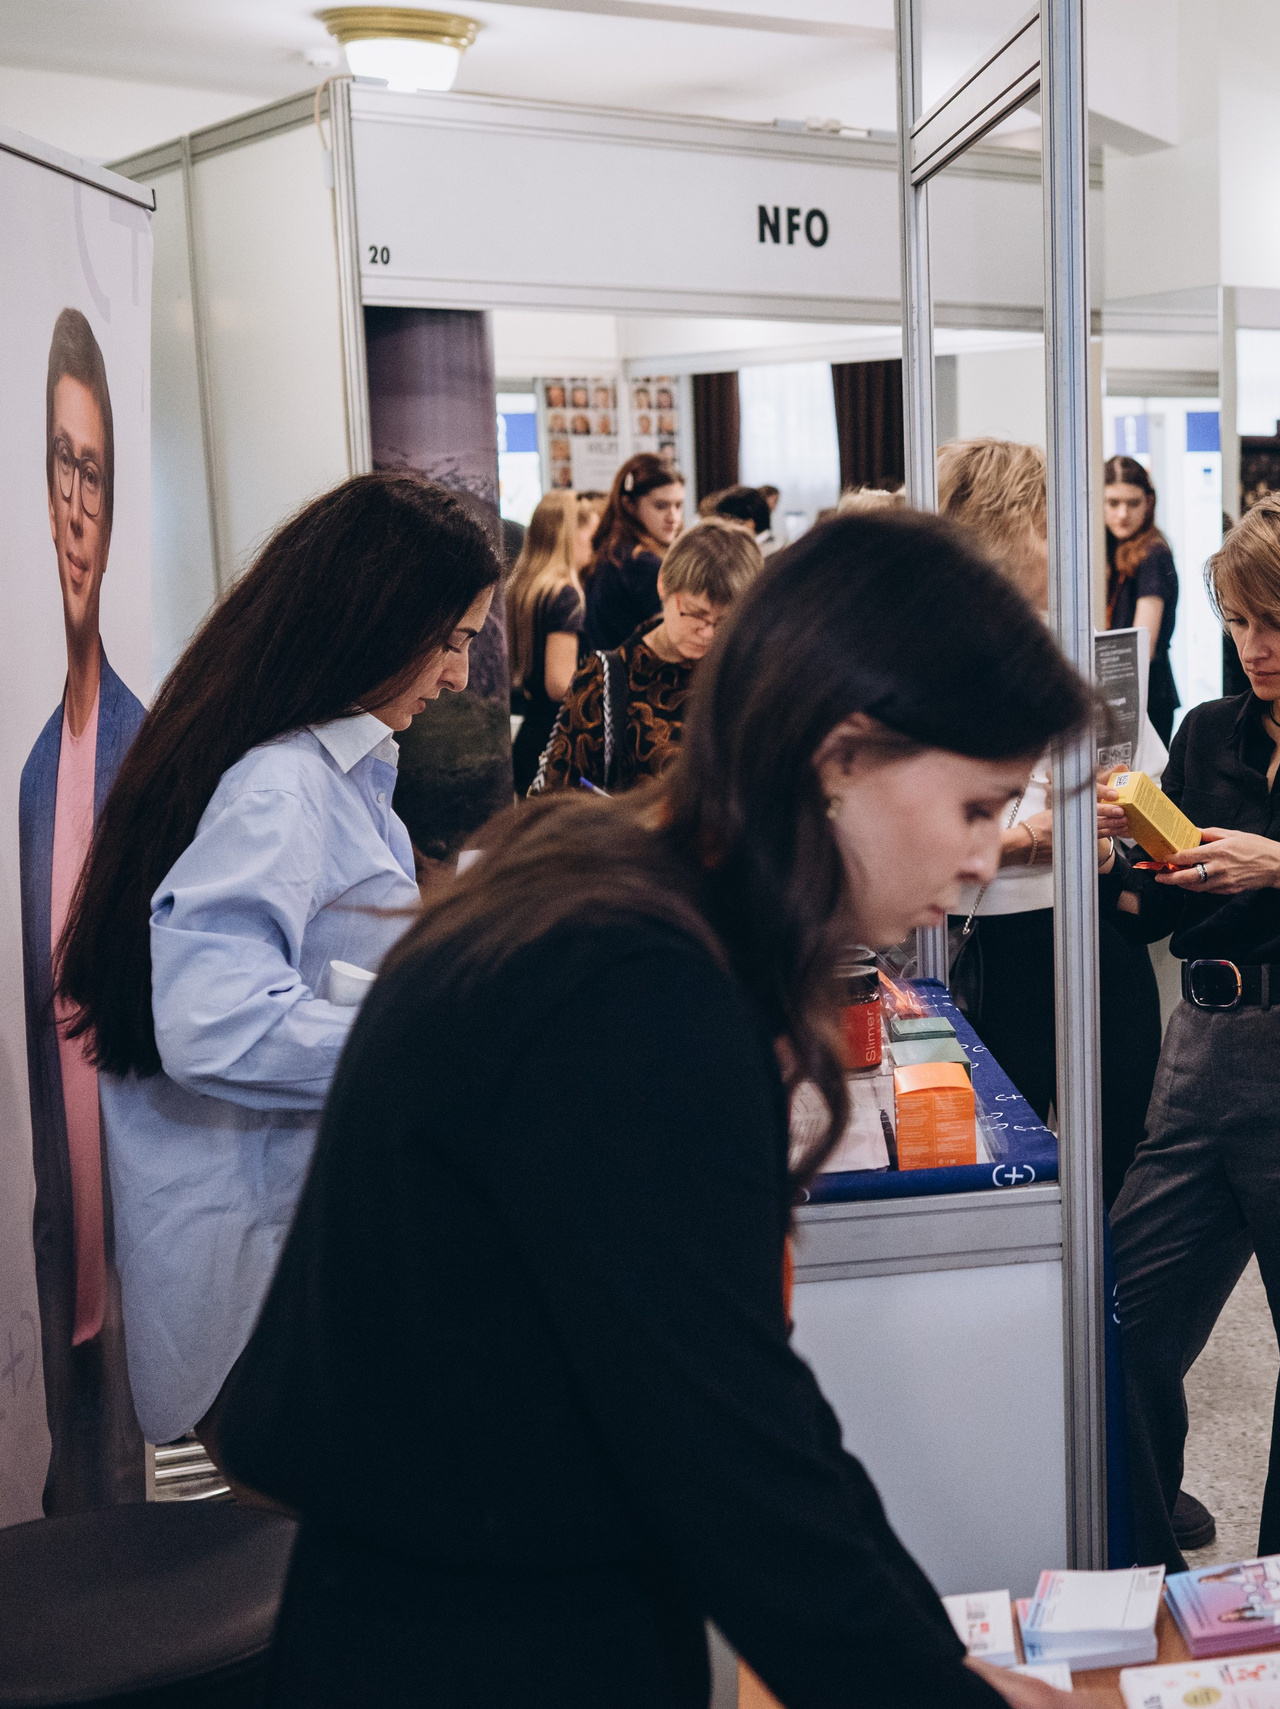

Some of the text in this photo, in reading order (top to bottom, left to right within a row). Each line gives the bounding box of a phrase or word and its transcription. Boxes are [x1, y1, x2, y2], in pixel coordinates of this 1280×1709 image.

[757, 205, 829, 247] NFO
[368, 245, 391, 265] 20
[865, 1008, 877, 1062] Slimer
